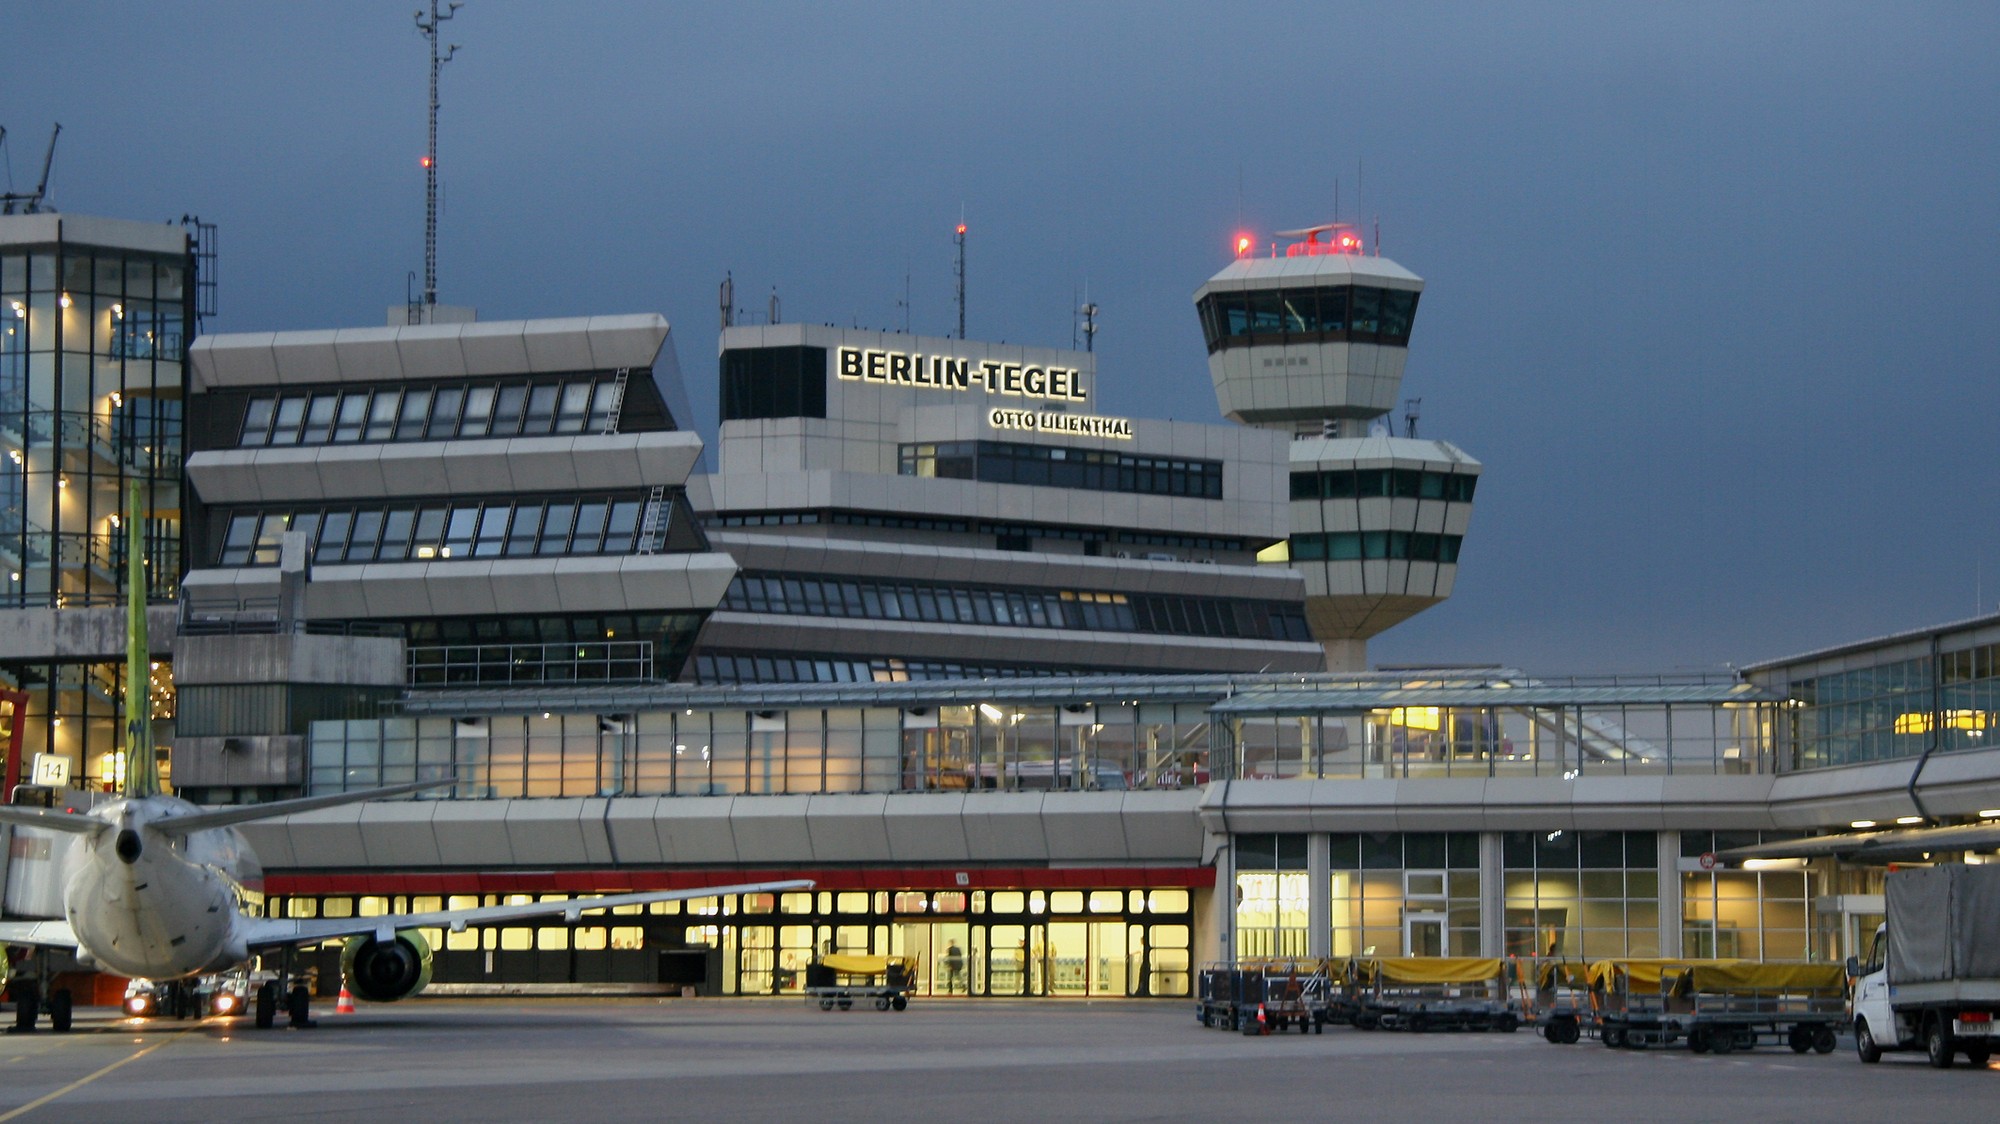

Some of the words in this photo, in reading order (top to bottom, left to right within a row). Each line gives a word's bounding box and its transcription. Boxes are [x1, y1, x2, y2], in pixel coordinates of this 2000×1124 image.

[838, 347, 1087, 400] BERLIN-TEGEL
[991, 408, 1036, 429] OTTO
[1038, 411, 1133, 438] LILIENTHAL
[43, 762, 62, 779] 14
